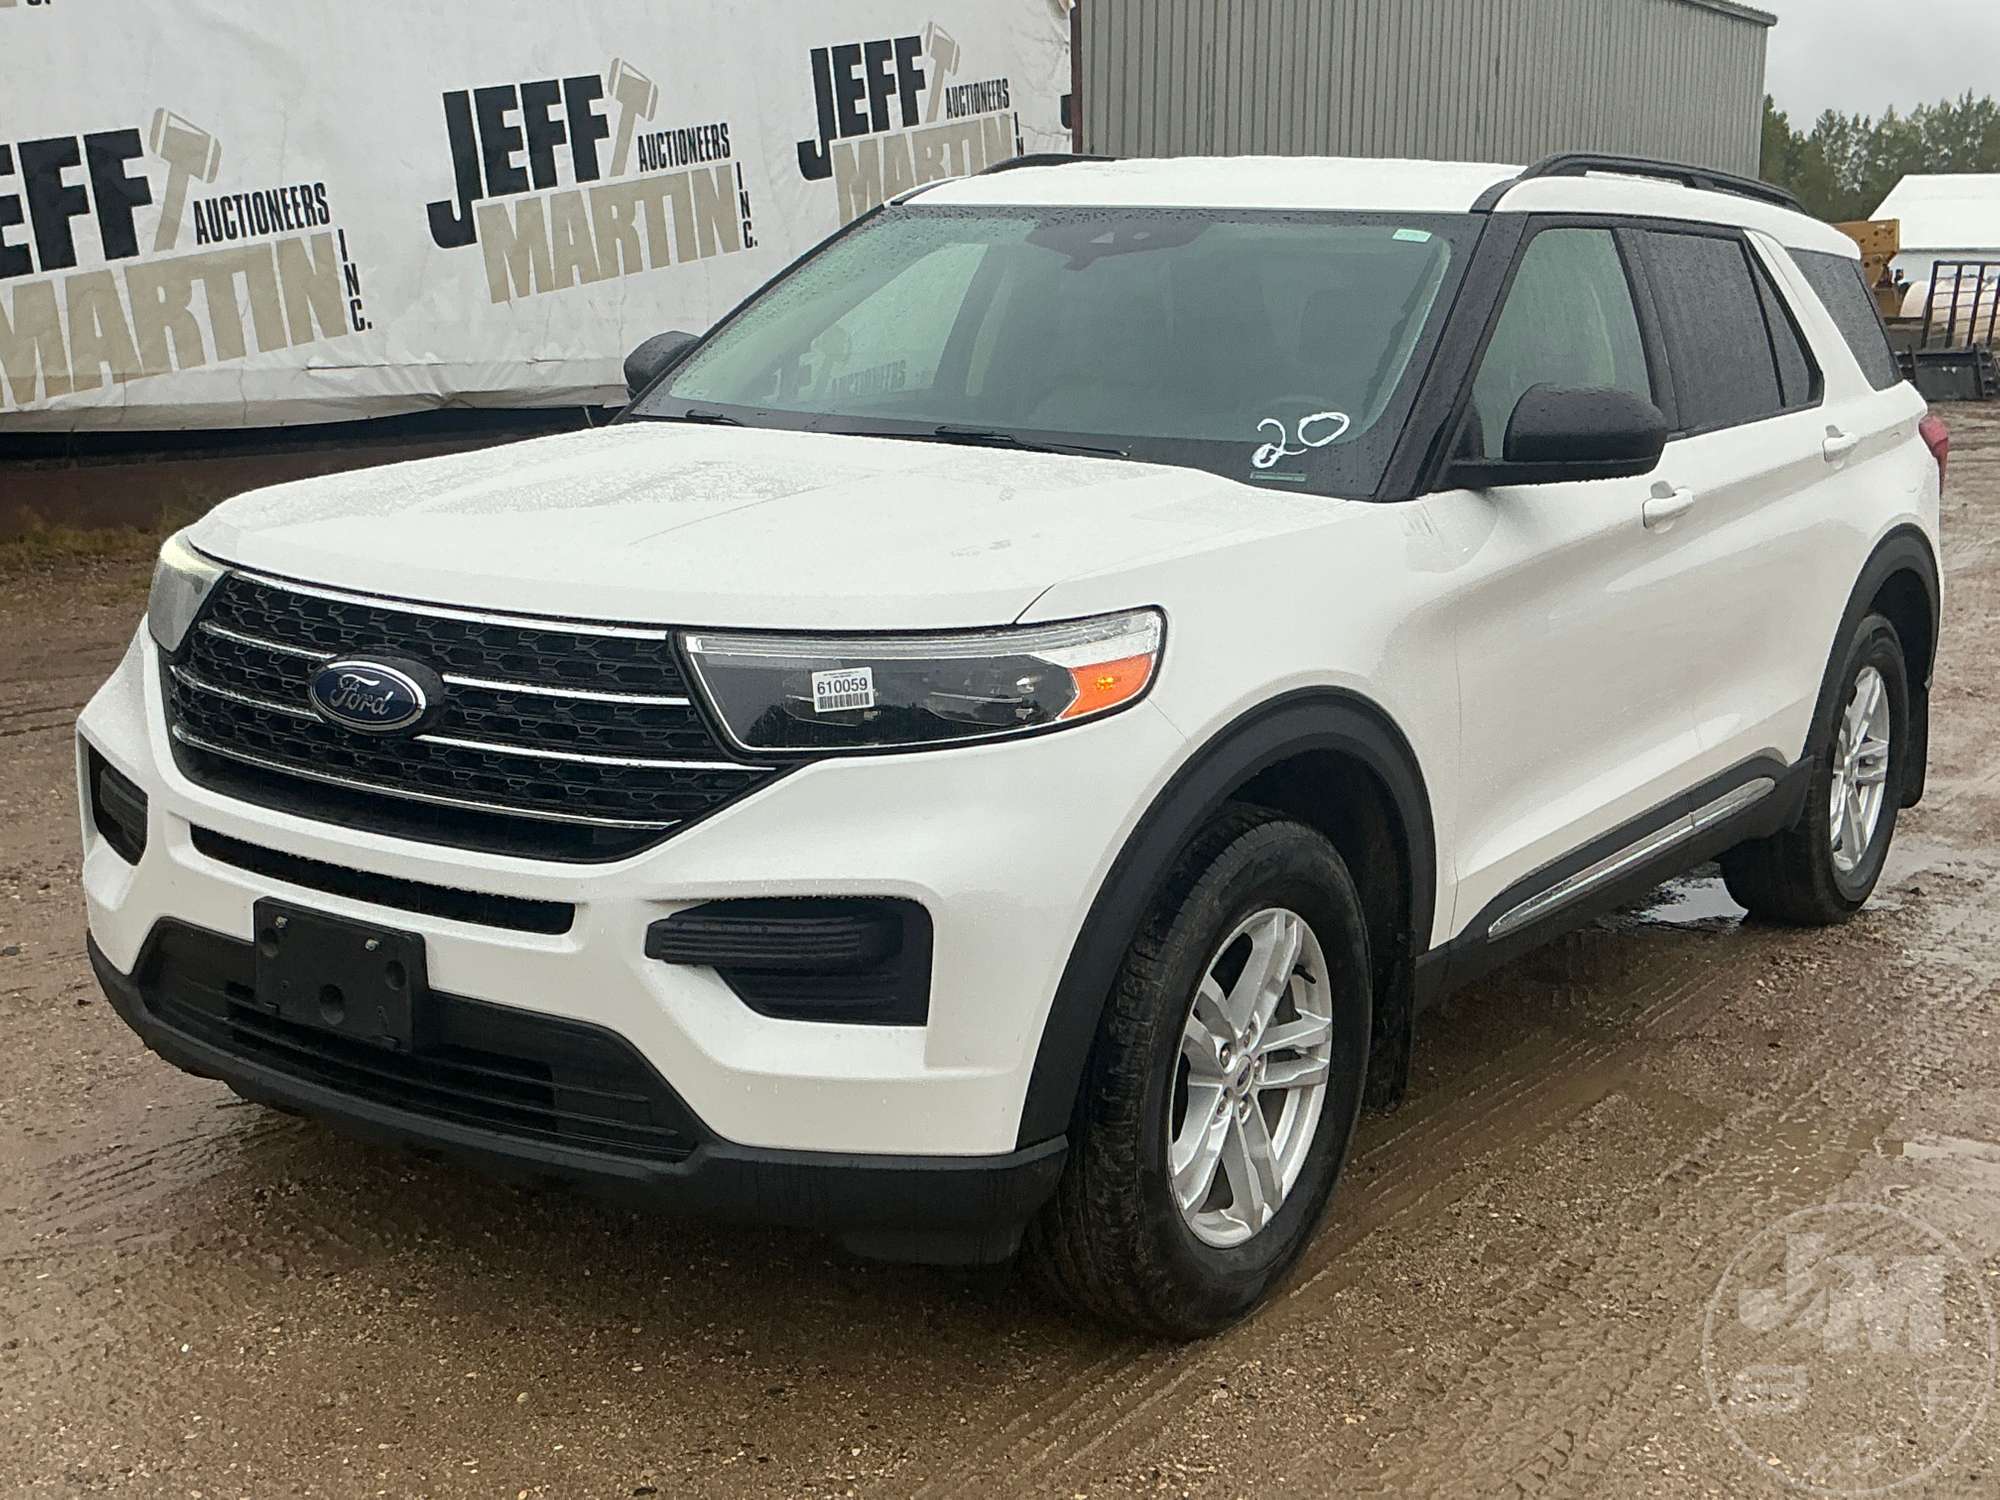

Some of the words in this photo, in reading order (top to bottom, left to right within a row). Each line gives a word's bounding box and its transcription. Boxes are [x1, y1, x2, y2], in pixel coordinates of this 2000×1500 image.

[797, 35, 927, 182] JEFF
[945, 78, 1010, 120] AUCTIONEERS
[426, 74, 610, 249] JEFF
[637, 122, 732, 173] AUCTIONEERS
[193, 182, 331, 246] AUCTIONEERS
[476, 164, 741, 304] MARTIN
[1251, 411, 1350, 469] 20
[329, 673, 394, 715] Ford
[817, 677, 868, 695] 610059
